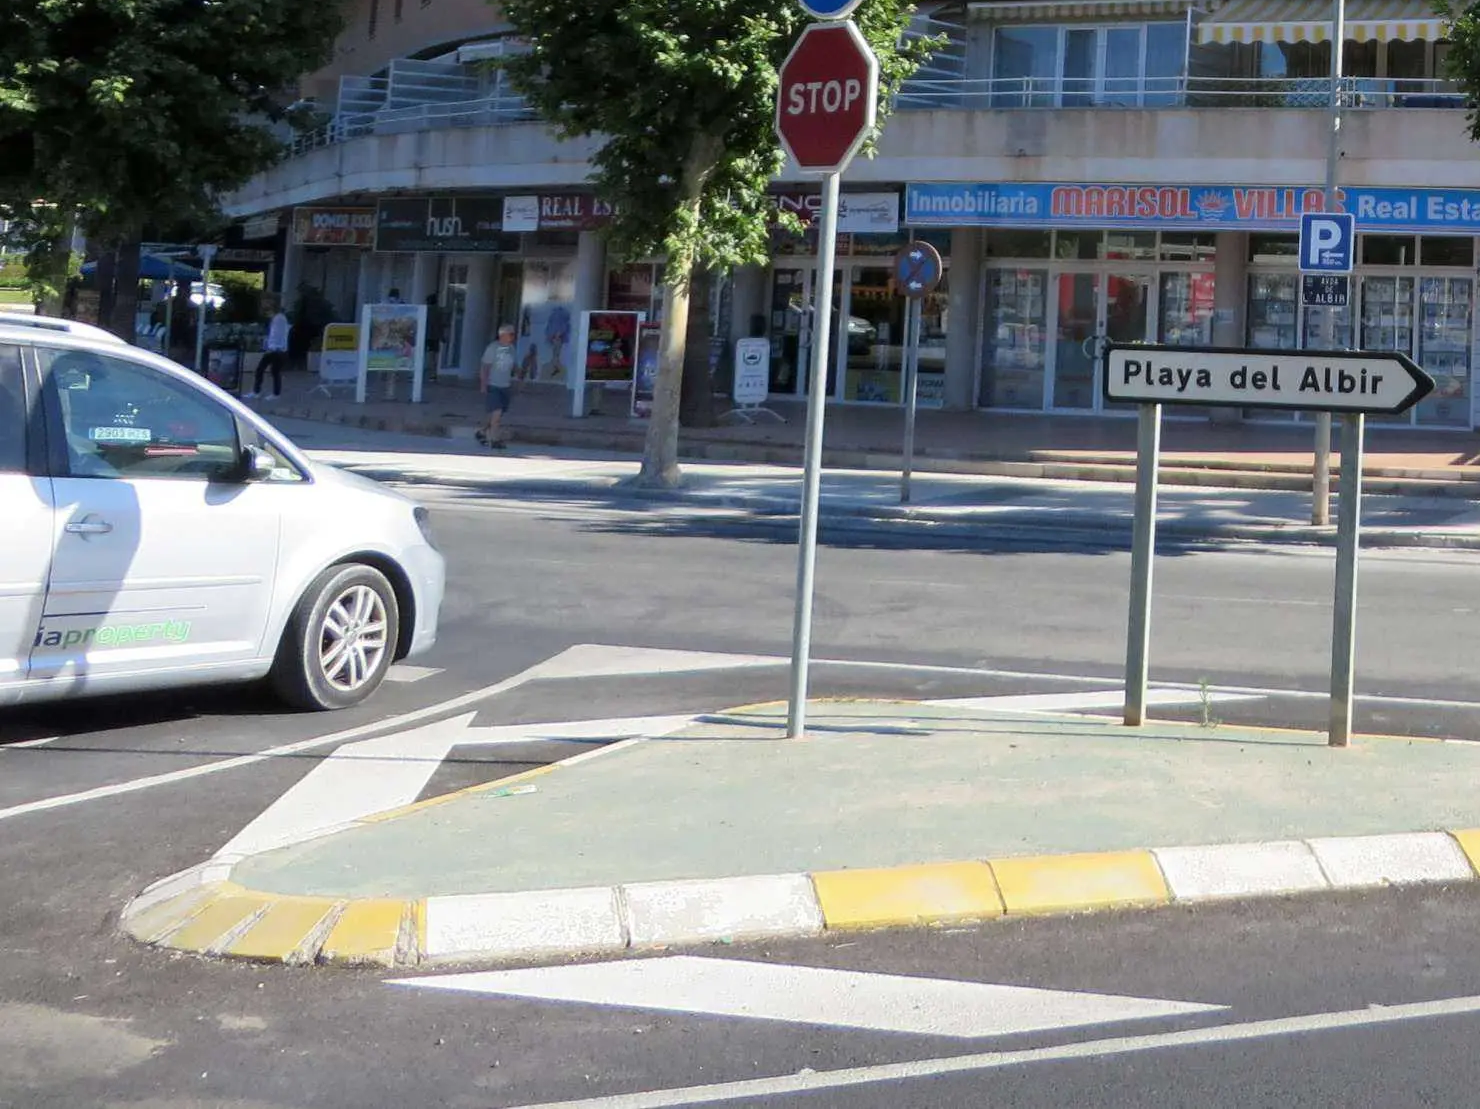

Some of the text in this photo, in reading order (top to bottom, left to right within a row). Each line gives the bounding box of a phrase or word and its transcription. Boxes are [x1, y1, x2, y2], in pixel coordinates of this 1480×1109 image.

[787, 79, 861, 115] STOP
[542, 196, 583, 216] REAL
[912, 191, 1038, 214] Inmobiliaria
[1050, 186, 1198, 219] MARISOL
[1358, 194, 1417, 219] Real
[1310, 220, 1342, 265] P
[1123, 359, 1384, 395] Playa del Albir
